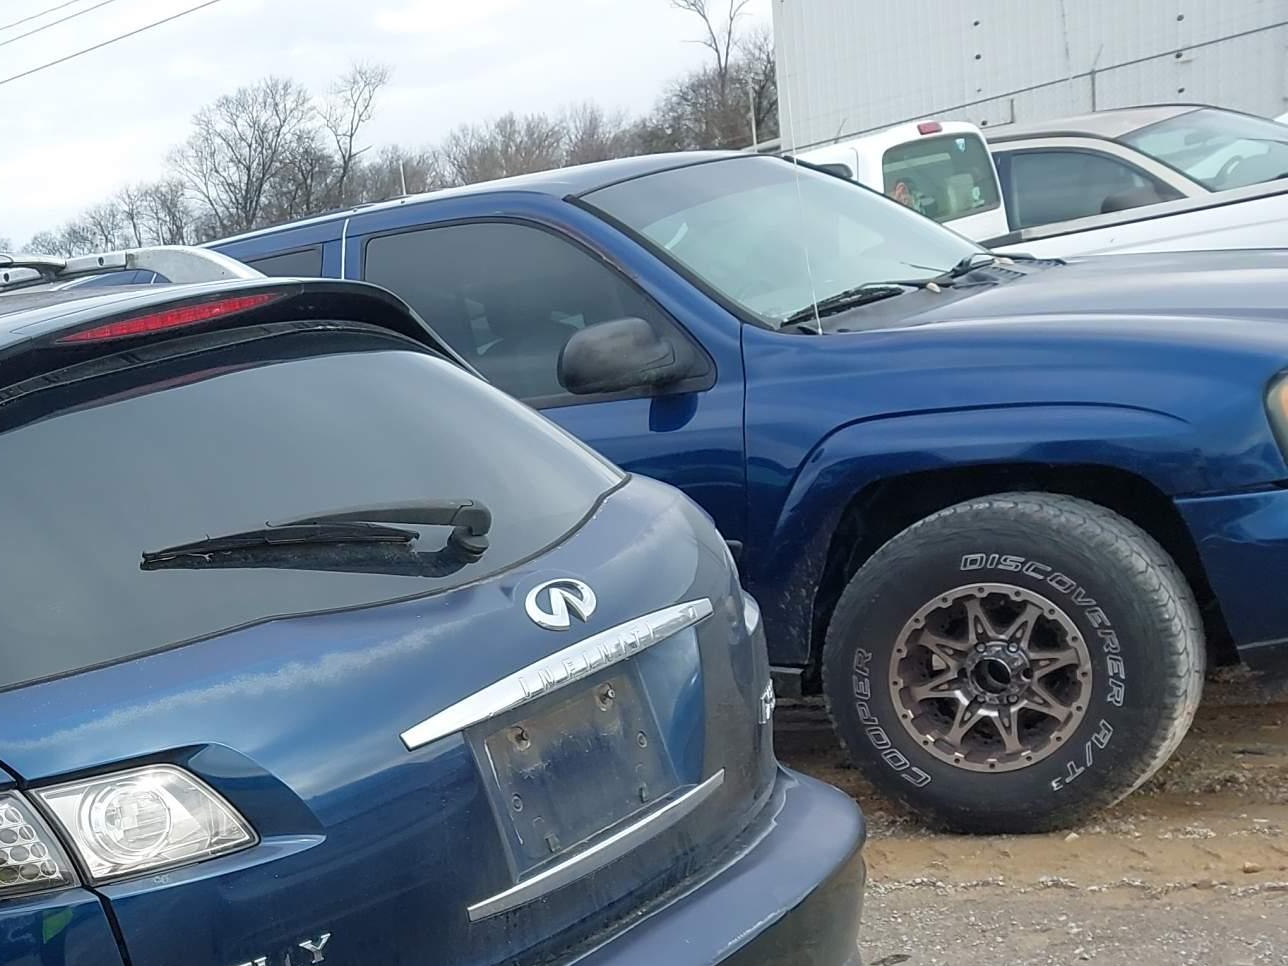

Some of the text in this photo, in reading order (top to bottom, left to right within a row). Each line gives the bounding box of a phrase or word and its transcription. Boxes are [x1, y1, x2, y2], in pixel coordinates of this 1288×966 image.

[518, 621, 656, 699] INFINITI
[960, 553, 1125, 706] DISCOVERER
[852, 648, 932, 788] COOPER
